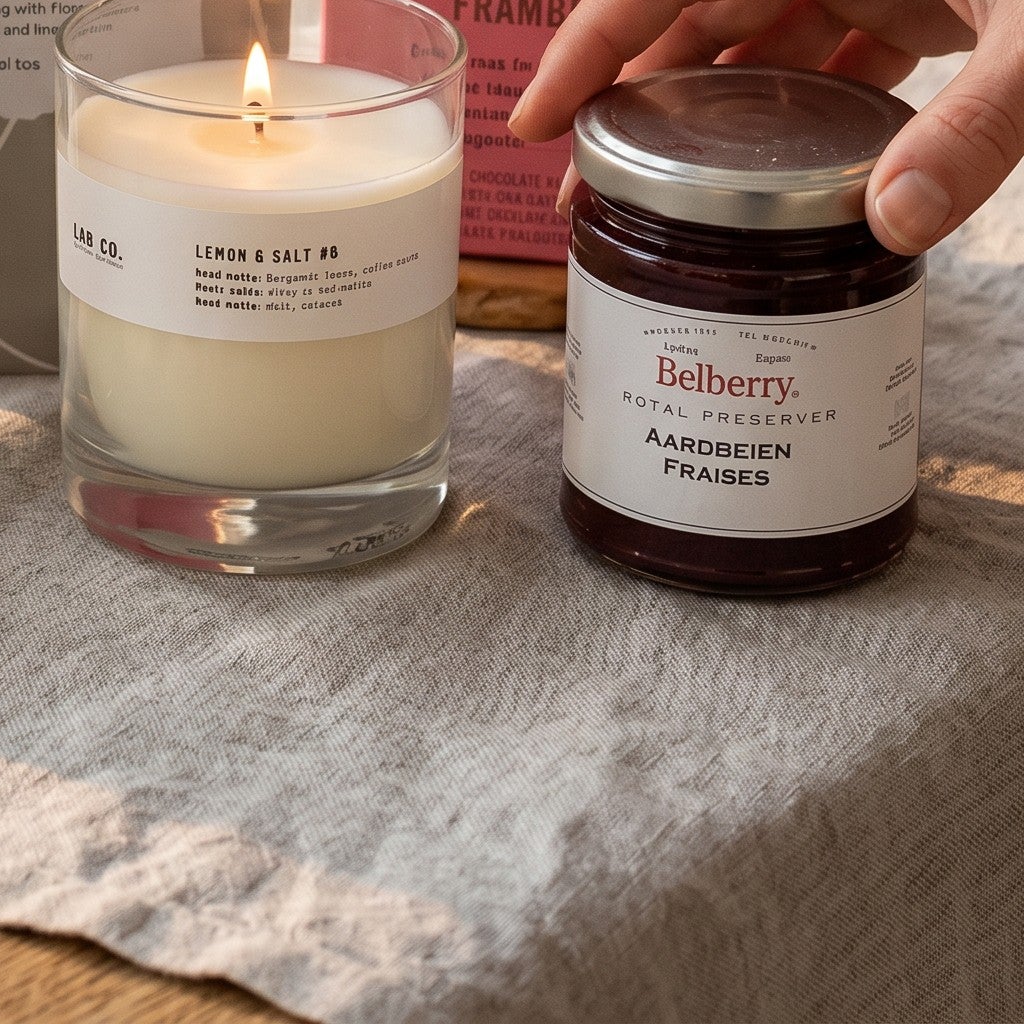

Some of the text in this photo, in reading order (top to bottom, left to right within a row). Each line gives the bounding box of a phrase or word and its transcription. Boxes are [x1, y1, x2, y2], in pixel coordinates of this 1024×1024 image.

[15, 3, 46, 15] with
[3, 23, 30, 36] and
[15, 58, 41, 71] tos
[73, 222, 94, 247] LAB
[100, 238, 123, 261] CO.
[195, 244, 247, 262] LEMON
[272, 248, 312, 264] SALT
[195, 268, 222, 280] head
[226, 272, 262, 283] notte:
[656, 355, 795, 405] Belberry
[622, 391, 837, 426] ROTAL PRESERVER
[644, 427, 792, 460] AARDBEIEN
[663, 457, 770, 486] FRAISES
